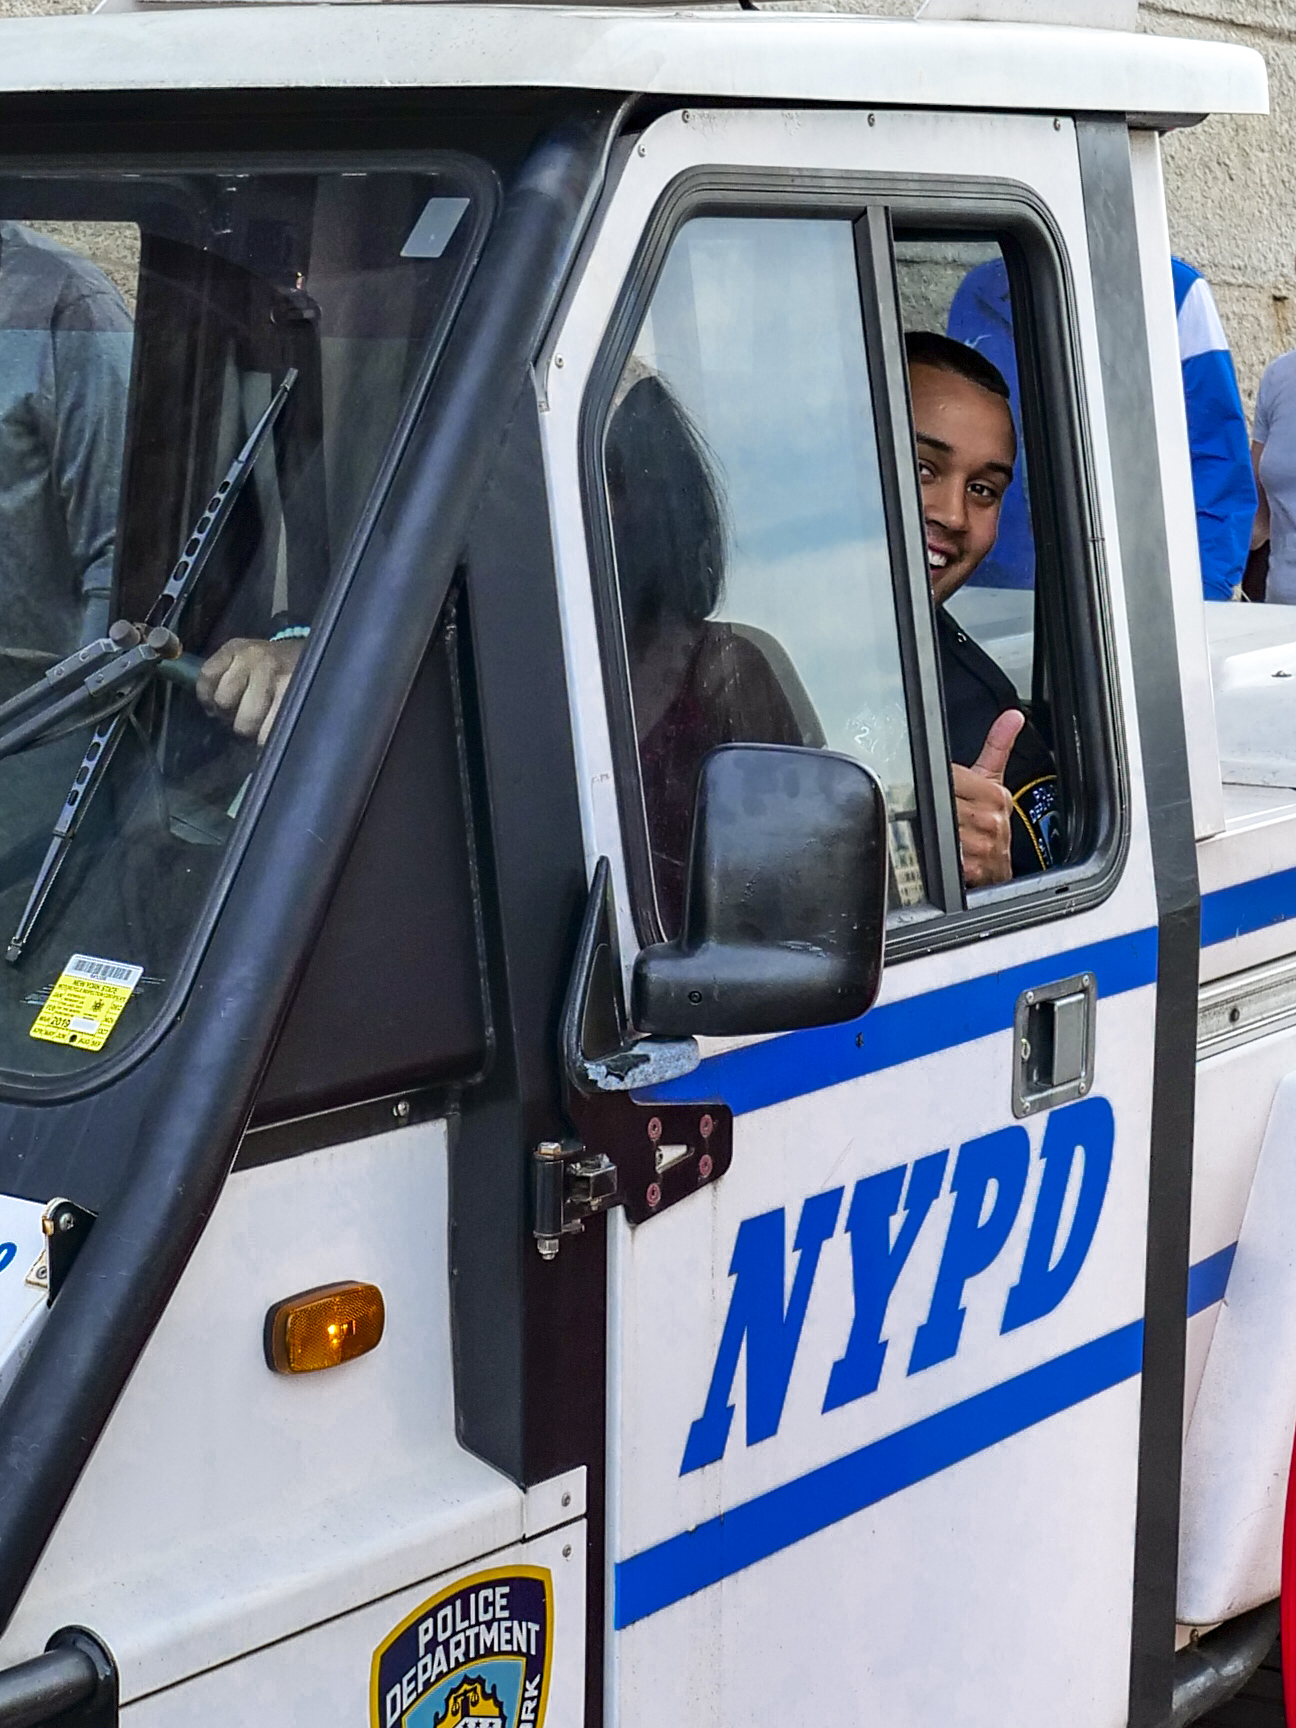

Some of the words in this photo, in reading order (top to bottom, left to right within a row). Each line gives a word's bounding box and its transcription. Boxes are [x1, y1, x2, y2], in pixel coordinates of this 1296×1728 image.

[50, 1016, 71, 1028] 2019
[678, 1096, 1117, 1477] NYPD
[417, 1586, 510, 1658] POLICE
